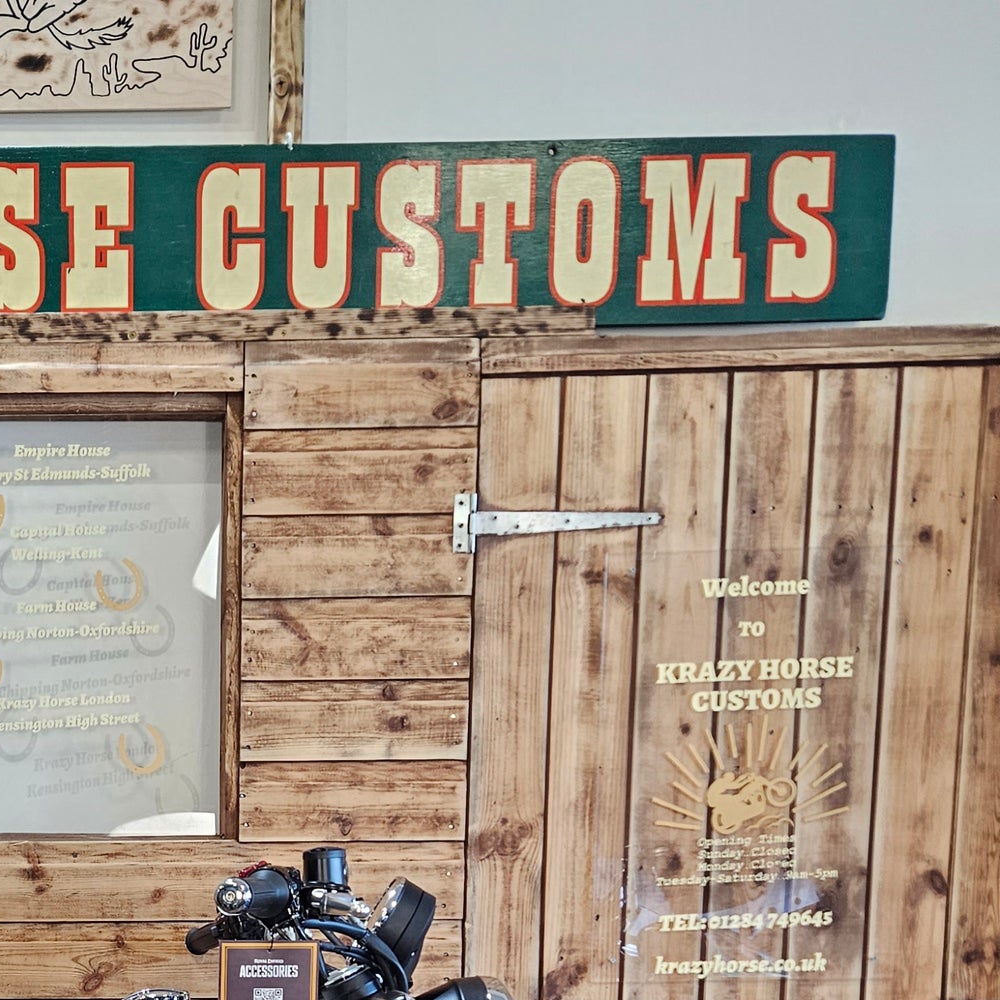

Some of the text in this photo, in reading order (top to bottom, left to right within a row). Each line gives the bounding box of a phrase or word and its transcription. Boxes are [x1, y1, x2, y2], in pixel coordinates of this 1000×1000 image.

[196, 151, 836, 311] CUSTOMS
[13, 443, 111, 461] Empire House
[13, 467, 29, 481] St
[30, 463, 151, 482] Edmunds-Suffolk
[10, 523, 62, 541] Capital
[63, 523, 107, 538] House
[10, 545, 105, 564] Welling-Kent
[701, 575, 810, 599] Welcome
[15, 600, 98, 615] Farm House
[25, 621, 160, 640] Norton-Oxfordshire
[738, 620, 766, 637] TO
[655, 655, 855, 685] KRAZY HORSE
[38, 695, 79, 708] Horse
[79, 692, 131, 706] London
[691, 686, 823, 713] CUSTOMS
[65, 713, 100, 729] High
[99, 711, 141, 725] Street
[697, 834, 796, 848] Opening Times
[765, 910, 834, 929] 749645
[239, 964, 299, 978] ACCESSORIES
[654, 952, 828, 979] krazyhorse.co.uk
